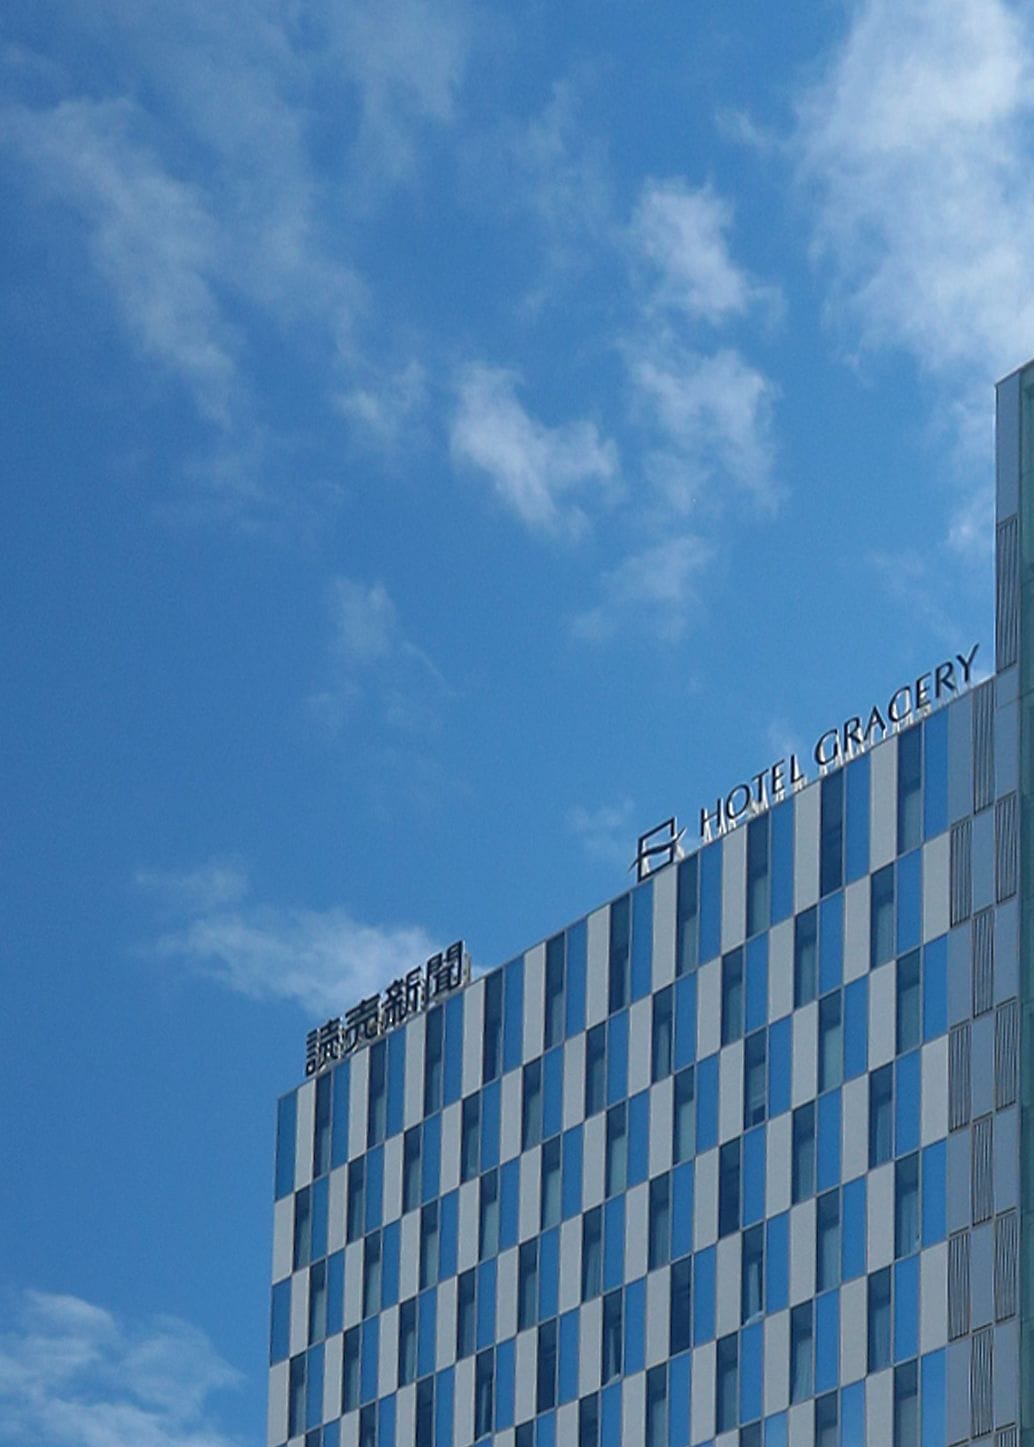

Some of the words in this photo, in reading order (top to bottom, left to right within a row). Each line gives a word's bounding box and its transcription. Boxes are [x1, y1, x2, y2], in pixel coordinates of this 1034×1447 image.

[700, 753, 805, 838] HOTEL
[813, 642, 981, 767] GRACERY
[305, 940, 464, 1077] 読売新聞
